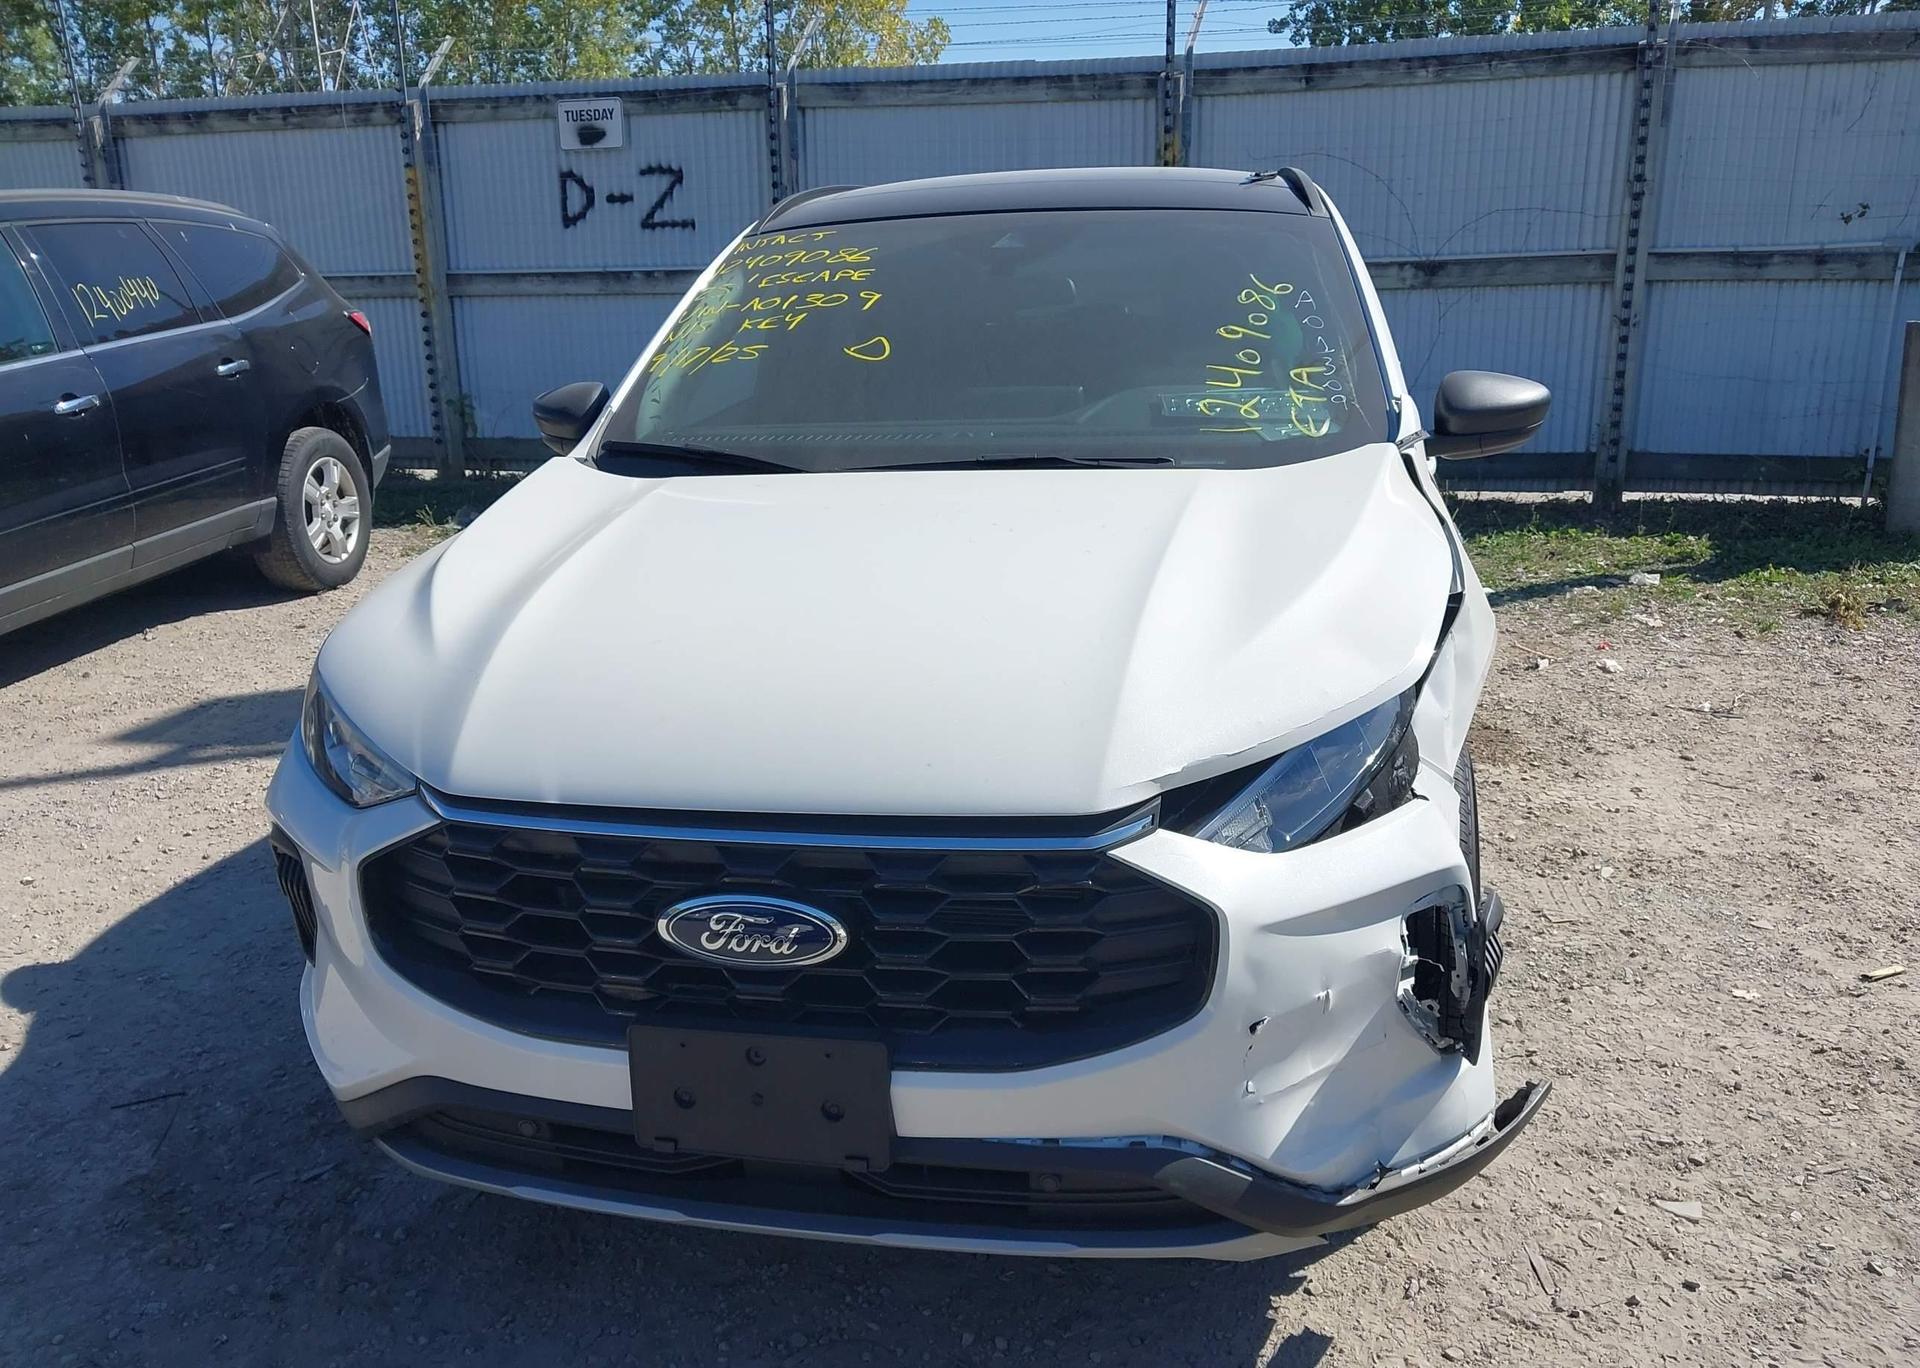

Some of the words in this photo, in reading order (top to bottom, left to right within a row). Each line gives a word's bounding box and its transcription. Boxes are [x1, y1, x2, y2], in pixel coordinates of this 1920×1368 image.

[564, 108, 615, 123] TUESDAY
[71, 275, 159, 328] 12400440
[738, 312, 809, 333] KEY
[1199, 273, 1294, 432] 12409086
[701, 912, 799, 955] Ford
